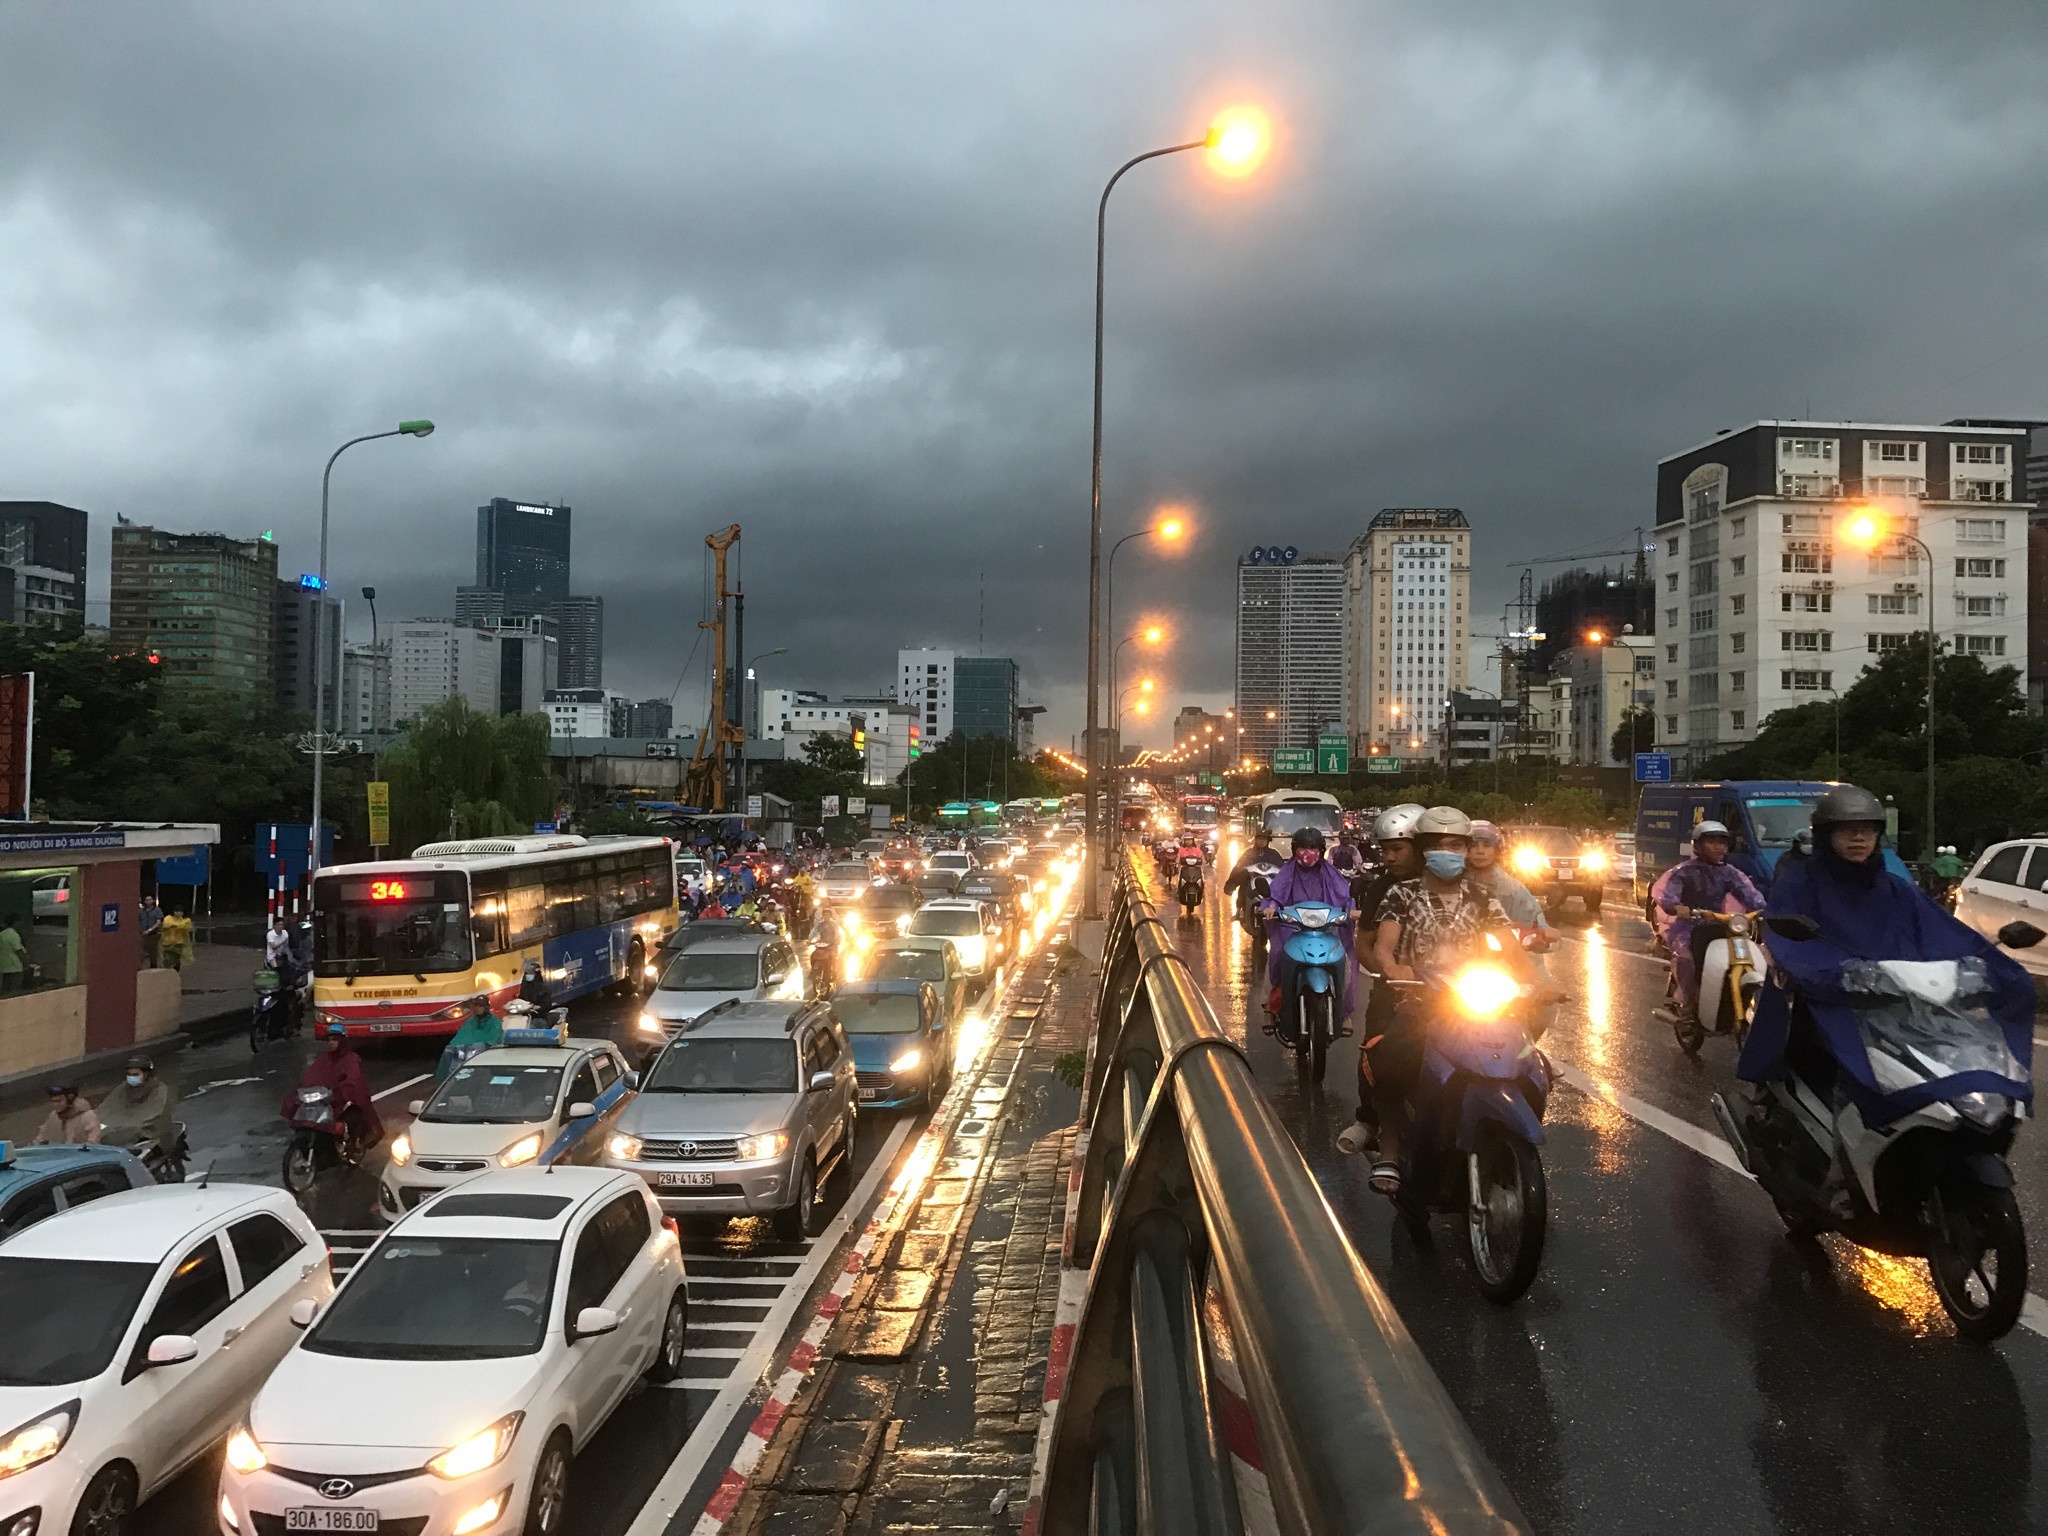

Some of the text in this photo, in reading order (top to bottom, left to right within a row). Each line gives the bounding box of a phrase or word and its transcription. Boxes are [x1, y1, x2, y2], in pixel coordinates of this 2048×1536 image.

[545, 507, 553, 516] 72
[69, 837, 93, 847] SANG
[371, 881, 405, 899] 34
[105, 910, 116, 925] H2
[660, 1173, 712, 1185] 29A-414.35
[288, 1510, 376, 1530] 30A-186.00
